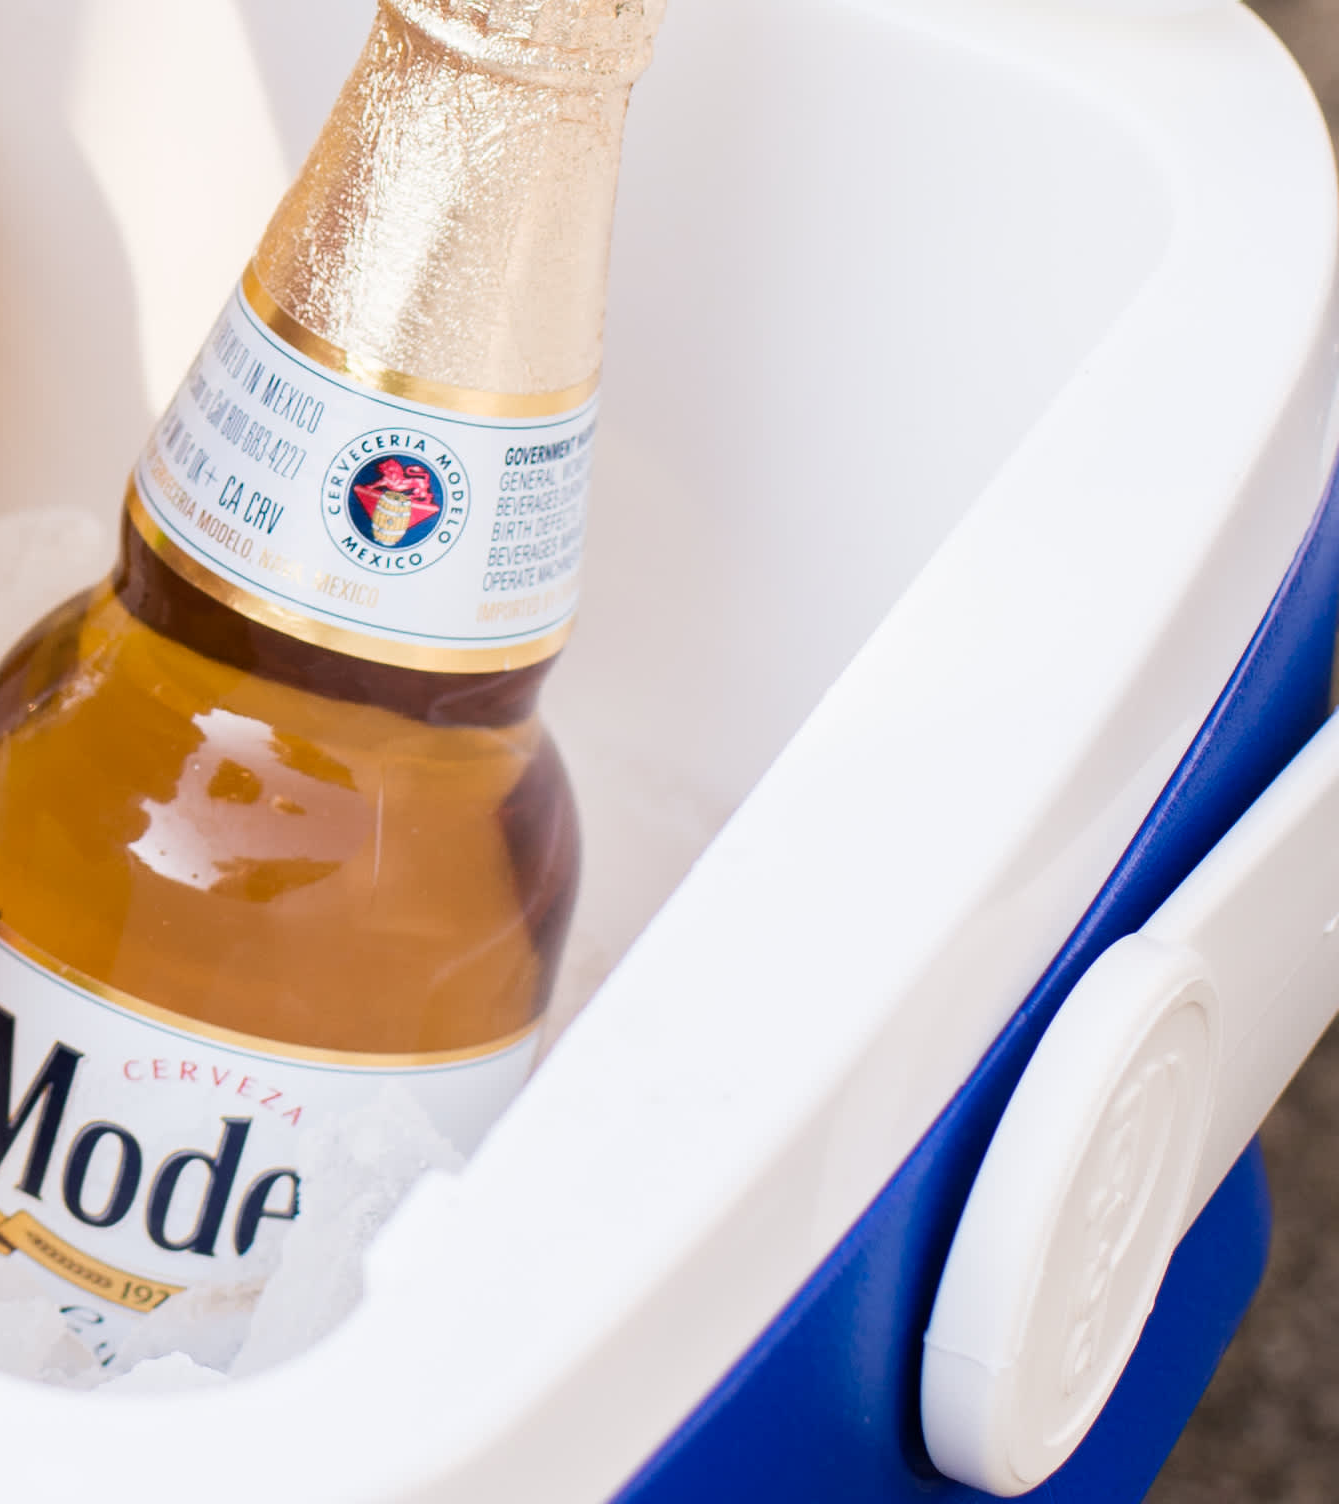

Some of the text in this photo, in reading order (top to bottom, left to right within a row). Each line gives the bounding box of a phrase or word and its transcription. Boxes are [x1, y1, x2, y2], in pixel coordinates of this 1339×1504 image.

[243, 359, 265, 394] IN
[260, 373, 324, 433] MEXICO
[219, 475, 244, 514] CA
[244, 492, 284, 534] CRV
[329, 434, 463, 543] CERVECERIA MODELO
[341, 536, 422, 569] MEXICO
[491, 521, 532, 542] BIRTH
[124, 1058, 303, 1126] CERVEZA
